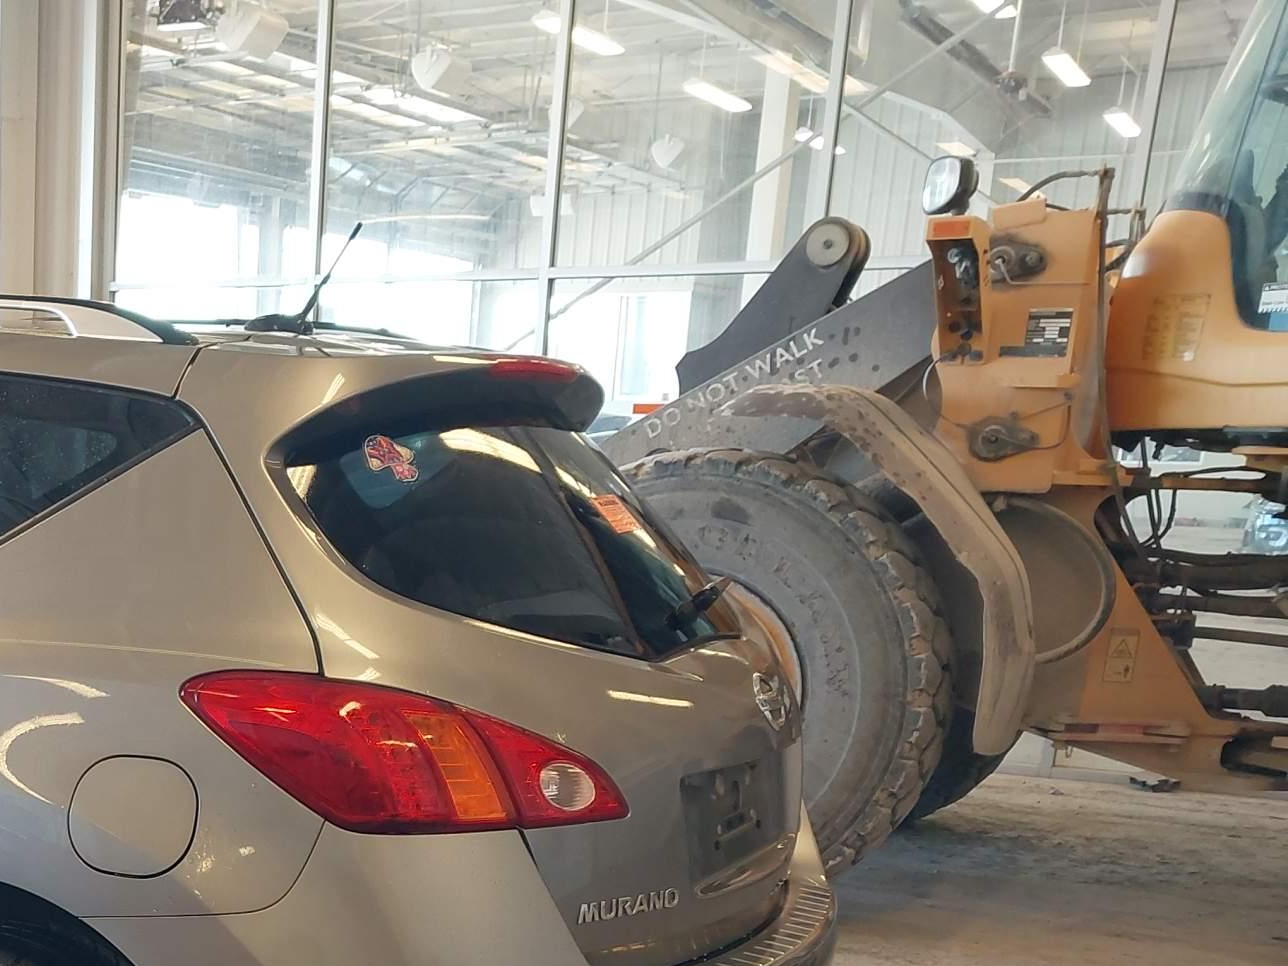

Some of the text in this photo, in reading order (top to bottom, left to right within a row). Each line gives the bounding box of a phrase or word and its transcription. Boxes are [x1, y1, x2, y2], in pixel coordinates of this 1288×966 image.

[643, 407, 681, 438] DO
[686, 371, 740, 410] NOT
[745, 327, 824, 379] WALK
[577, 887, 680, 925] MURANO
